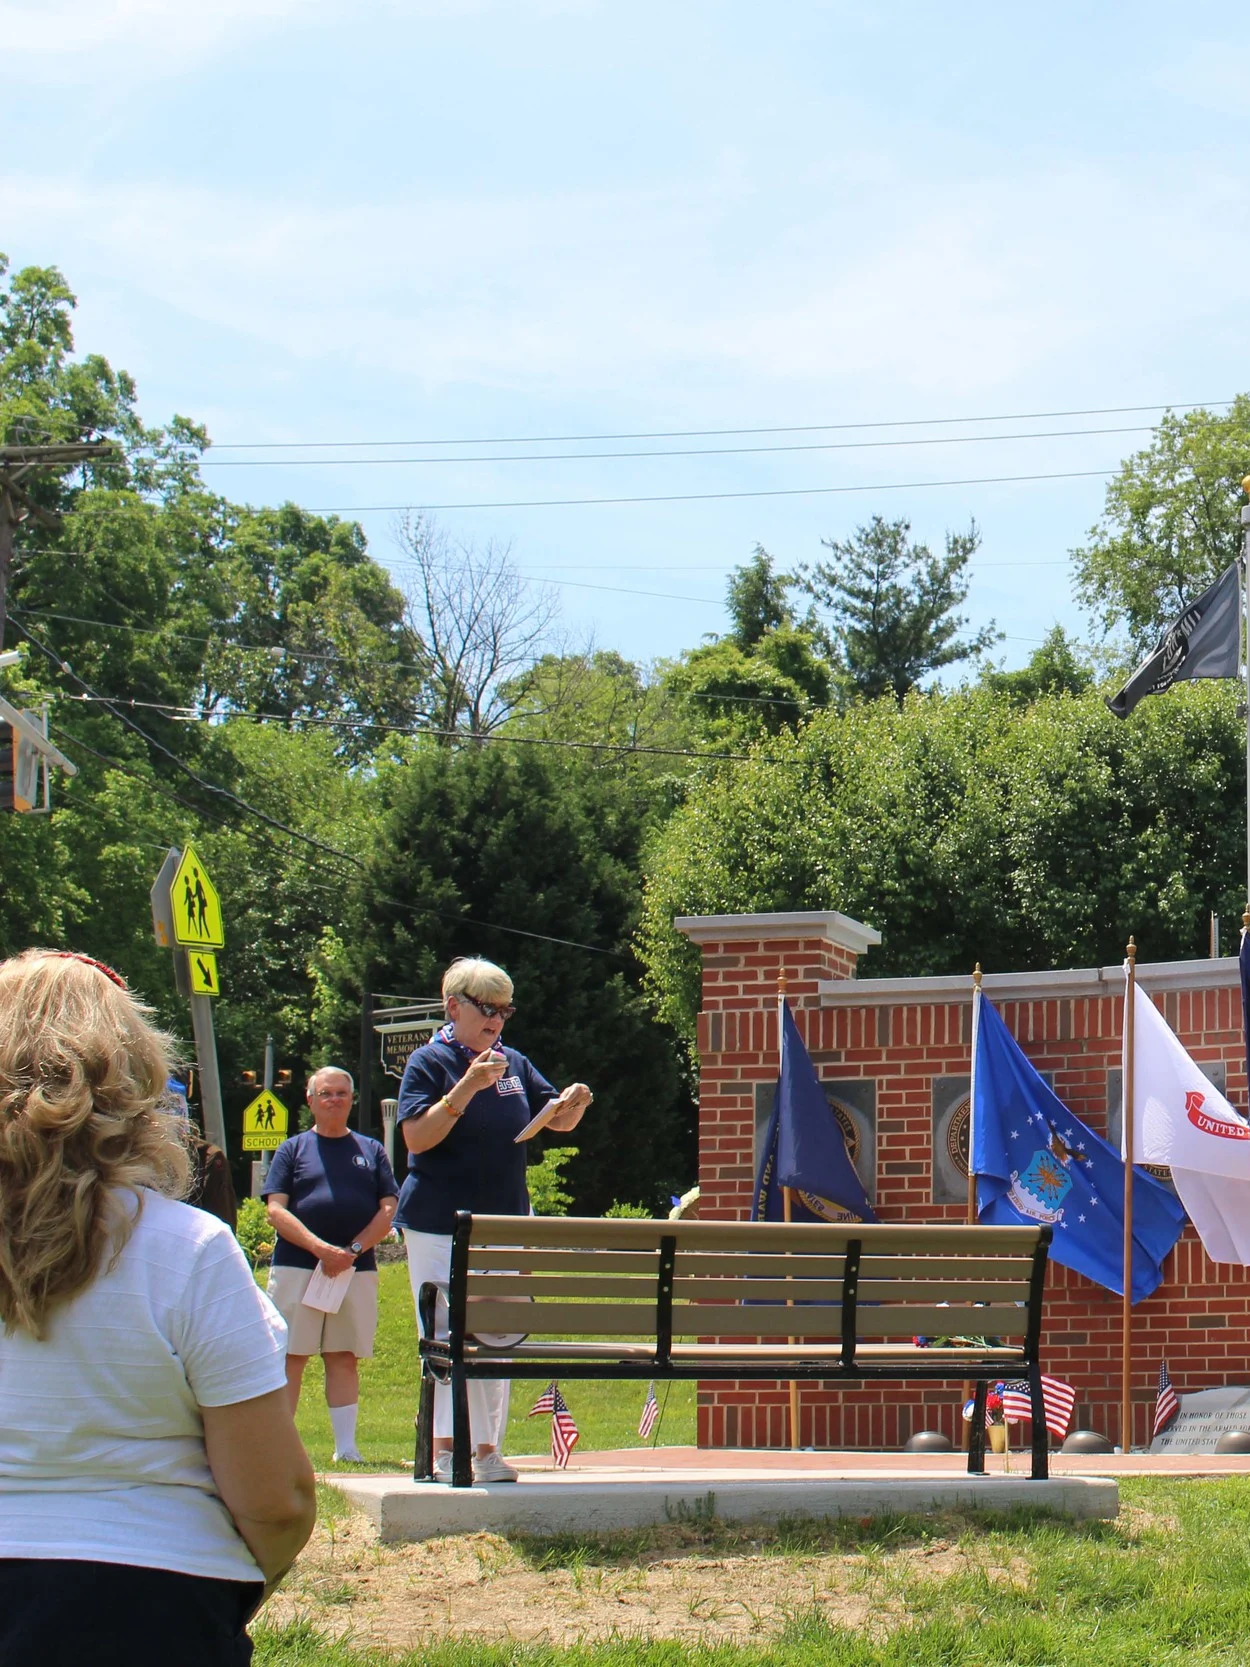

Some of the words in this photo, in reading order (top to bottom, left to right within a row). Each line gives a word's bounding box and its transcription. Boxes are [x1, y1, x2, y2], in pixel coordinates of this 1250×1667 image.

[387, 1031, 430, 1043] VETERANS
[386, 1043, 422, 1054] MEMORI
[951, 1101, 971, 1155] DEPARTMEN
[1197, 1115, 1245, 1137] UNITED
[1180, 1411, 1187, 1419] IN
[1189, 1411, 1212, 1419] HONOR
[1214, 1411, 1223, 1419] OF
[1226, 1411, 1247, 1419] THOSE
[1161, 1438, 1173, 1446] THE
[1175, 1438, 1200, 1446] UNITED
[1201, 1438, 1217, 1446] STAT
